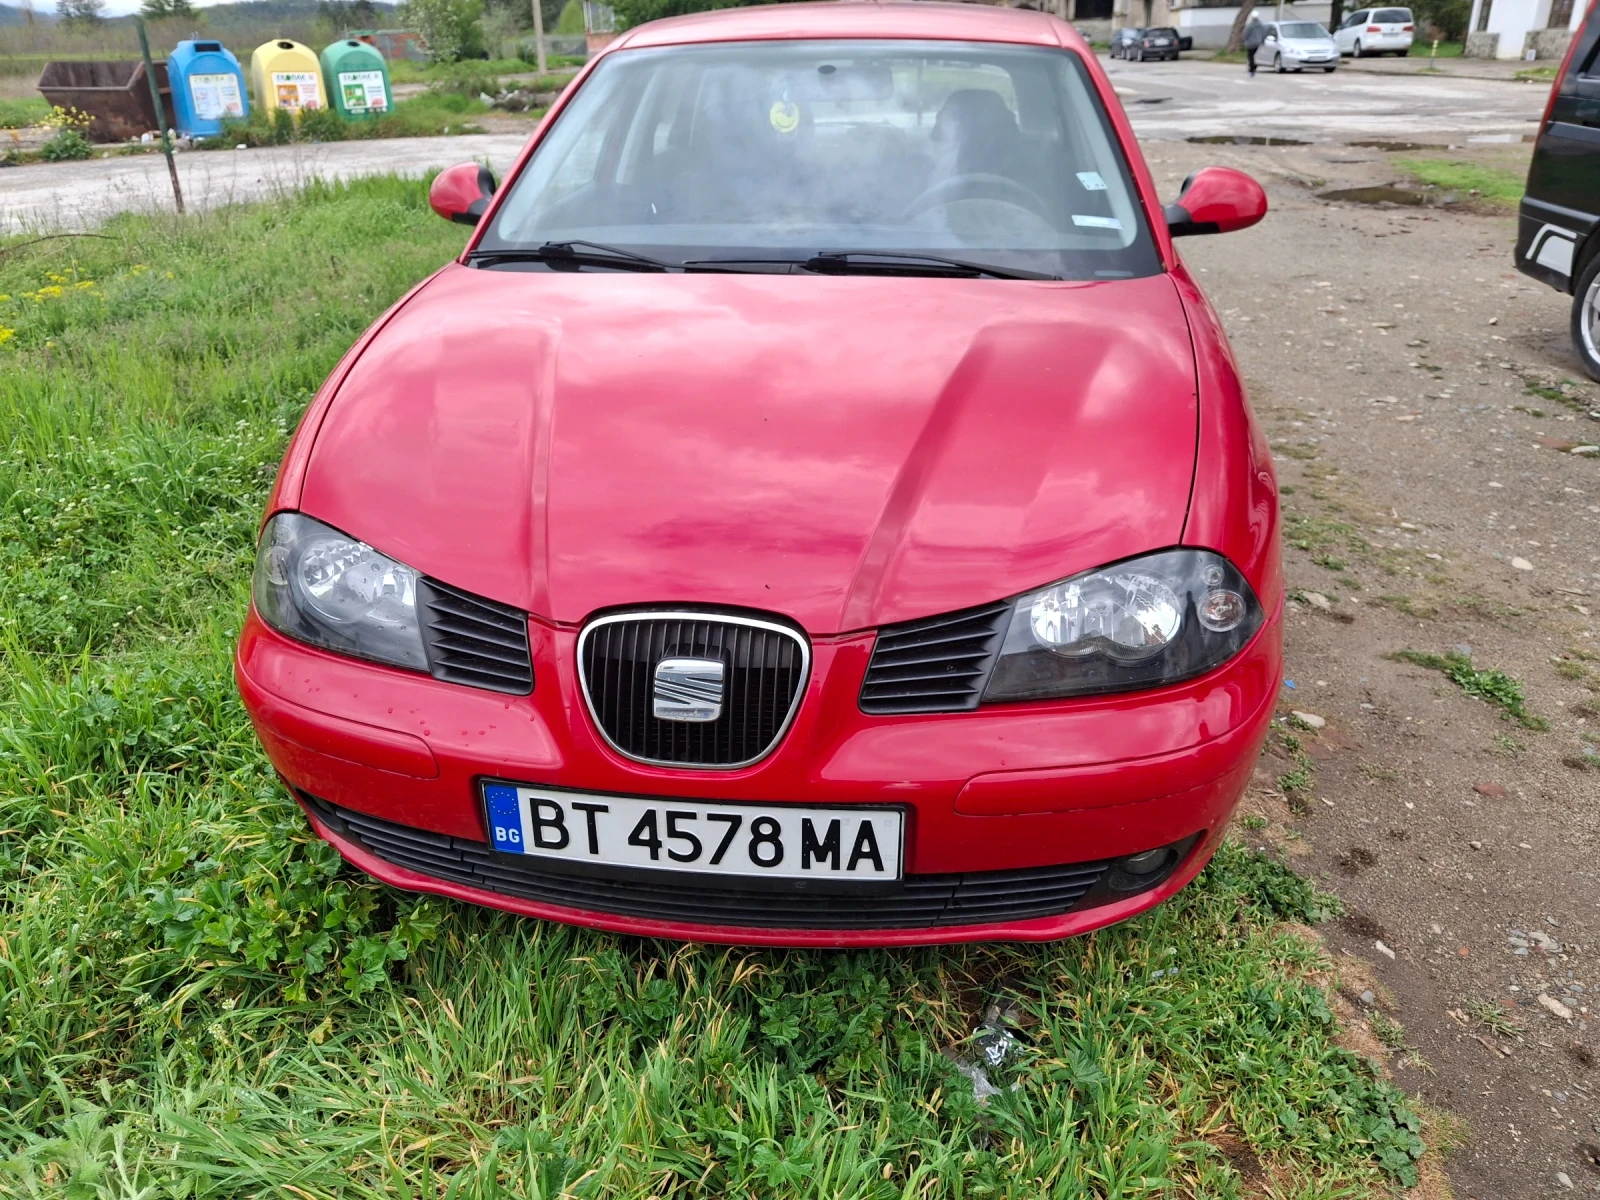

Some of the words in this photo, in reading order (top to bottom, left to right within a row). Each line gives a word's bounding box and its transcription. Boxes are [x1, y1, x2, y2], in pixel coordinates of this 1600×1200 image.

[495, 826, 520, 843] BG
[529, 797, 609, 854] BT
[627, 808, 784, 868] 4578
[801, 817, 884, 871] MA
